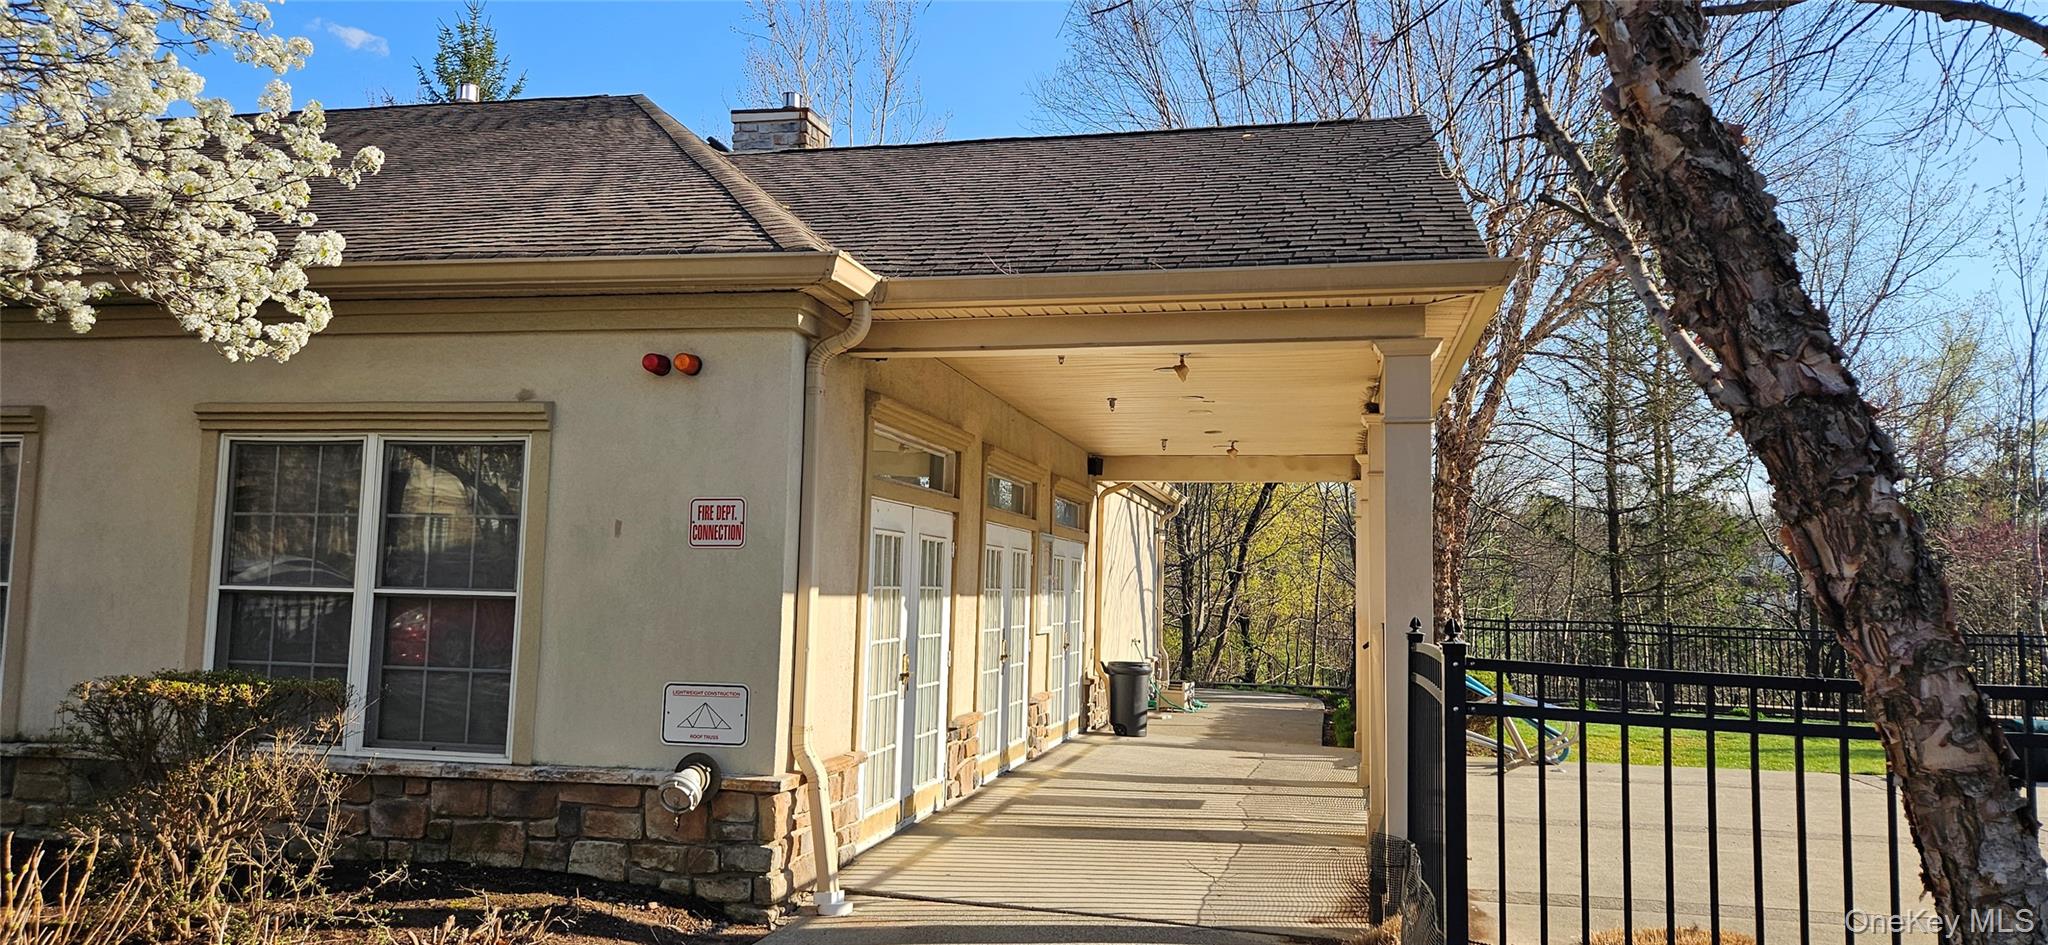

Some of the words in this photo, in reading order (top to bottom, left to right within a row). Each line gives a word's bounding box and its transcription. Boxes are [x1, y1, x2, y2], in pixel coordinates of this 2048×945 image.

[698, 505, 714, 520] FIRE
[716, 505, 737, 520] DEPT.
[692, 524, 742, 540] CONNECTION
